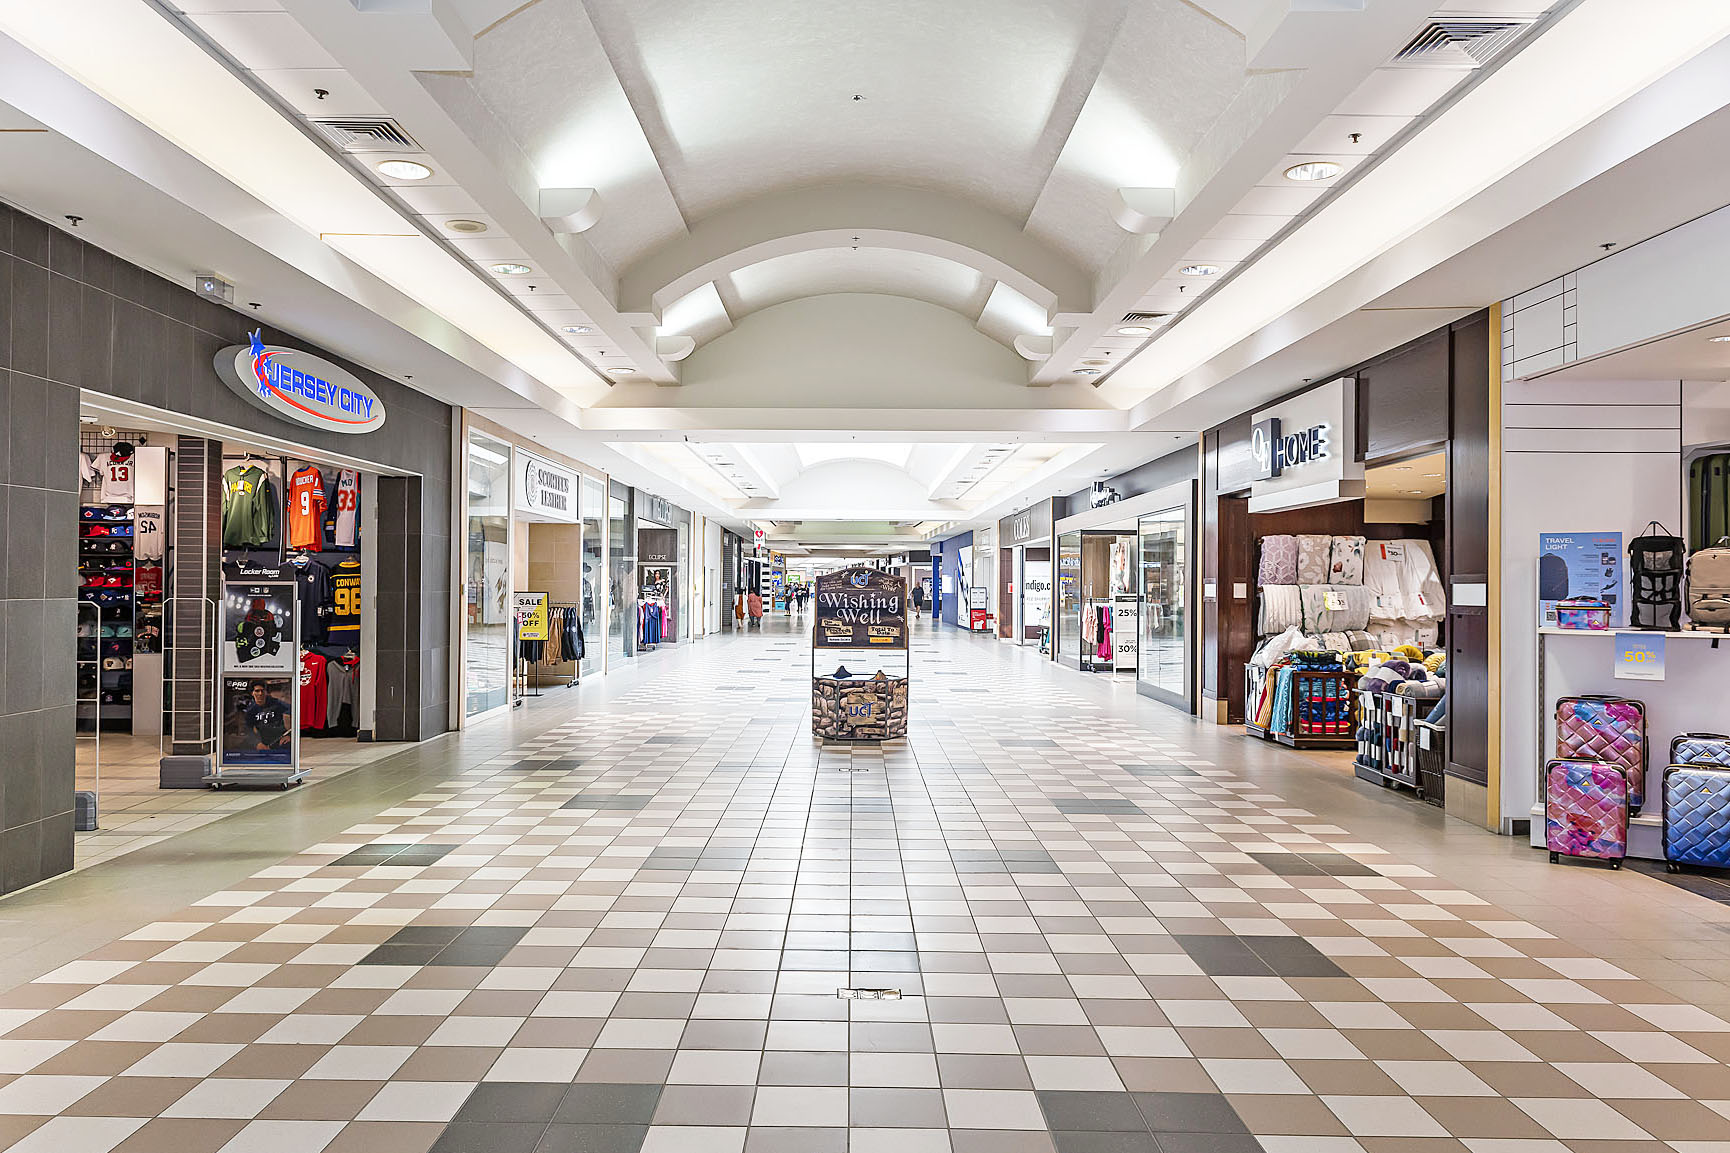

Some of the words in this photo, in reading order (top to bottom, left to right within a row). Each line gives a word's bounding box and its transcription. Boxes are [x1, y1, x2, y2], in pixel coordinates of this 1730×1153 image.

[268, 362, 338, 407] JERSEY
[338, 387, 374, 419] CITY
[1276, 426, 1325, 469] HOME
[110, 466, 129, 482] 13
[300, 491, 310, 516] 9
[337, 489, 357, 512] 33
[336, 578, 361, 588] CONWA
[850, 571, 873, 587] UCT
[1025, 579, 1051, 592] ndigo.c
[519, 598, 543, 606] SALE
[819, 592, 899, 613] Wishing
[521, 611, 540, 619] 50%
[837, 608, 882, 625] Well
[1118, 609, 1138, 617] 25%
[1118, 645, 1137, 653] 30%
[849, 702, 875, 718] UCT
